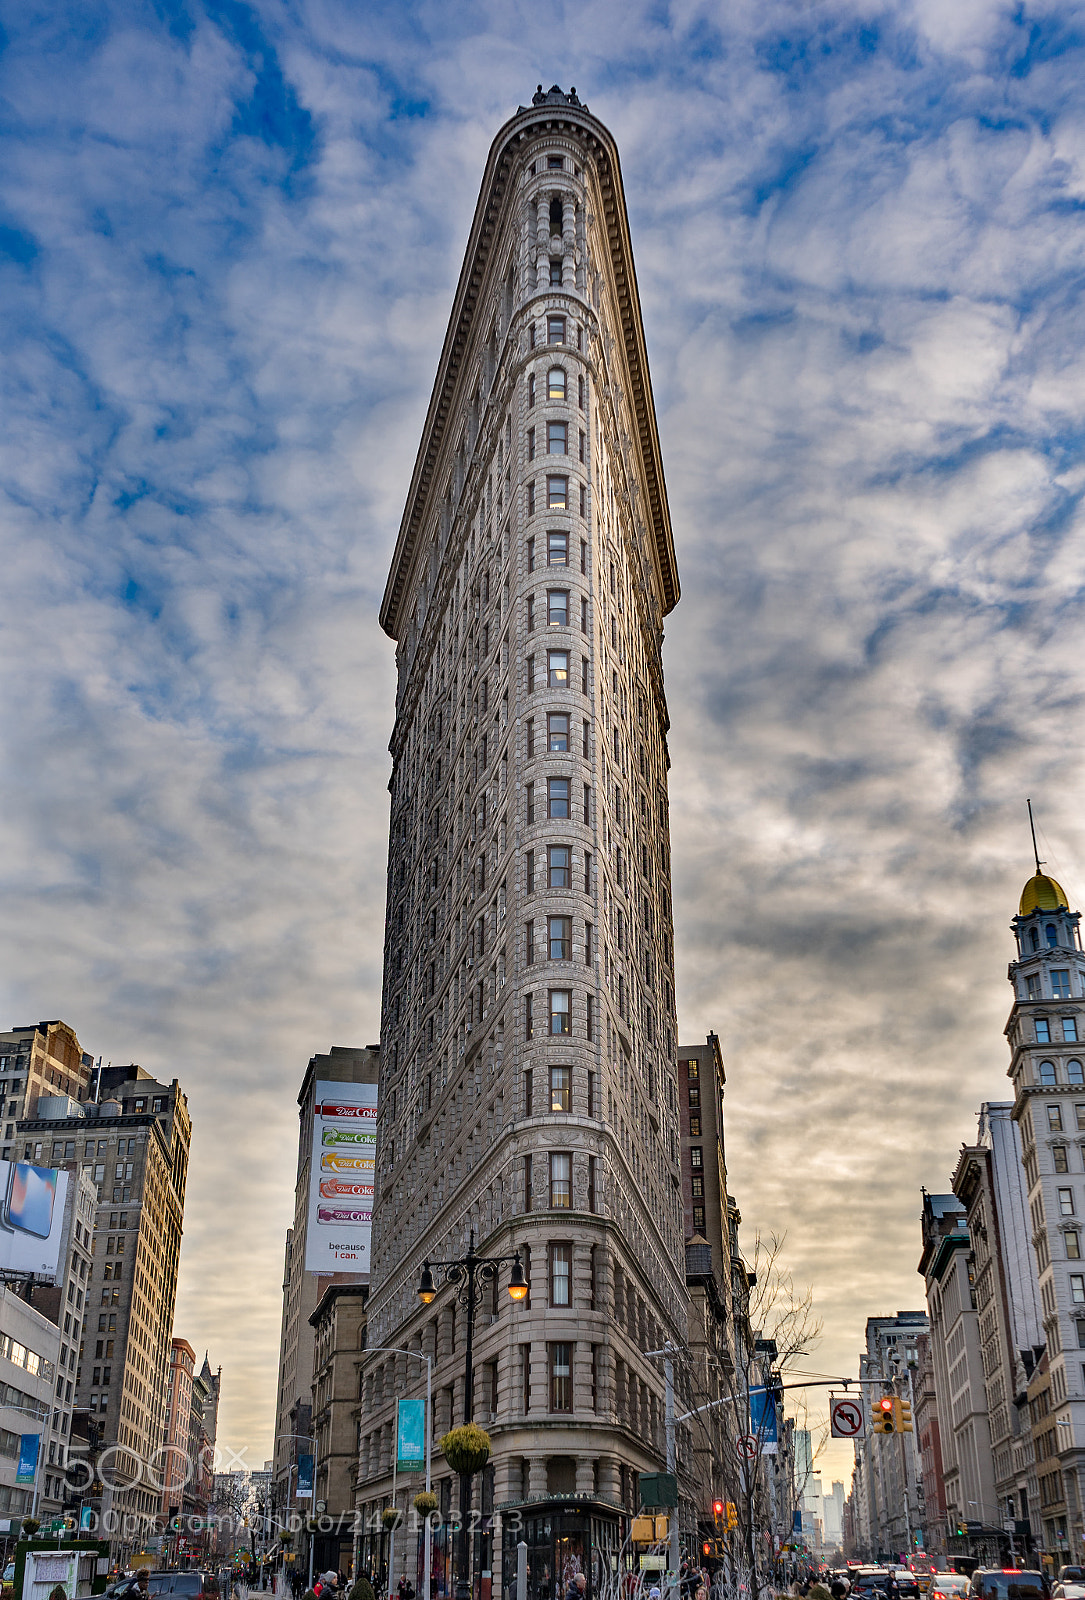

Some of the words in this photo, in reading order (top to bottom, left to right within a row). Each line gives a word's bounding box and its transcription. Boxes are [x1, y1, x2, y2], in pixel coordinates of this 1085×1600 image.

[336, 1106, 355, 1116] Diet
[354, 1133, 377, 1144] Coke
[336, 1185, 351, 1193] Diet
[351, 1185, 375, 1195] Coke
[335, 1211, 350, 1219] Diet
[329, 1242, 366, 1251] because
[335, 1251, 338, 1259] I
[340, 1252, 359, 1260] can.
